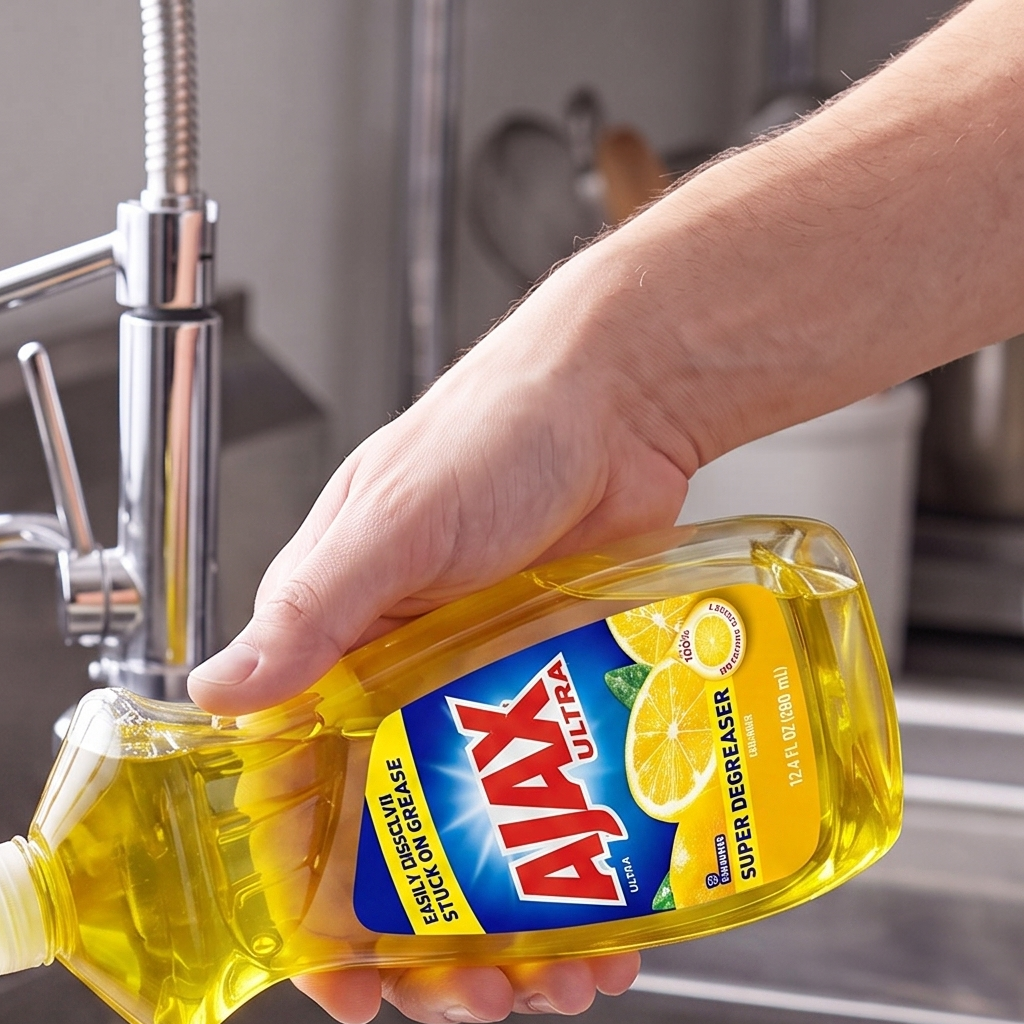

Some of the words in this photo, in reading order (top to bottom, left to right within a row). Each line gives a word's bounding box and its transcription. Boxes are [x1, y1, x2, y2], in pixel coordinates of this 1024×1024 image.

[681, 629, 693, 662] 100%
[547, 659, 595, 760] ULTRA
[782, 723, 796, 741] OZ
[713, 687, 748, 812] DEGREASER
[784, 743, 798, 764] FL
[386, 757, 422, 833] GREASE
[455, 677, 623, 901] AJAX
[412, 835, 433, 863] ON
[733, 815, 757, 880] SUPER
[406, 874, 439, 925] EASILY
[423, 864, 459, 922] STUCK
